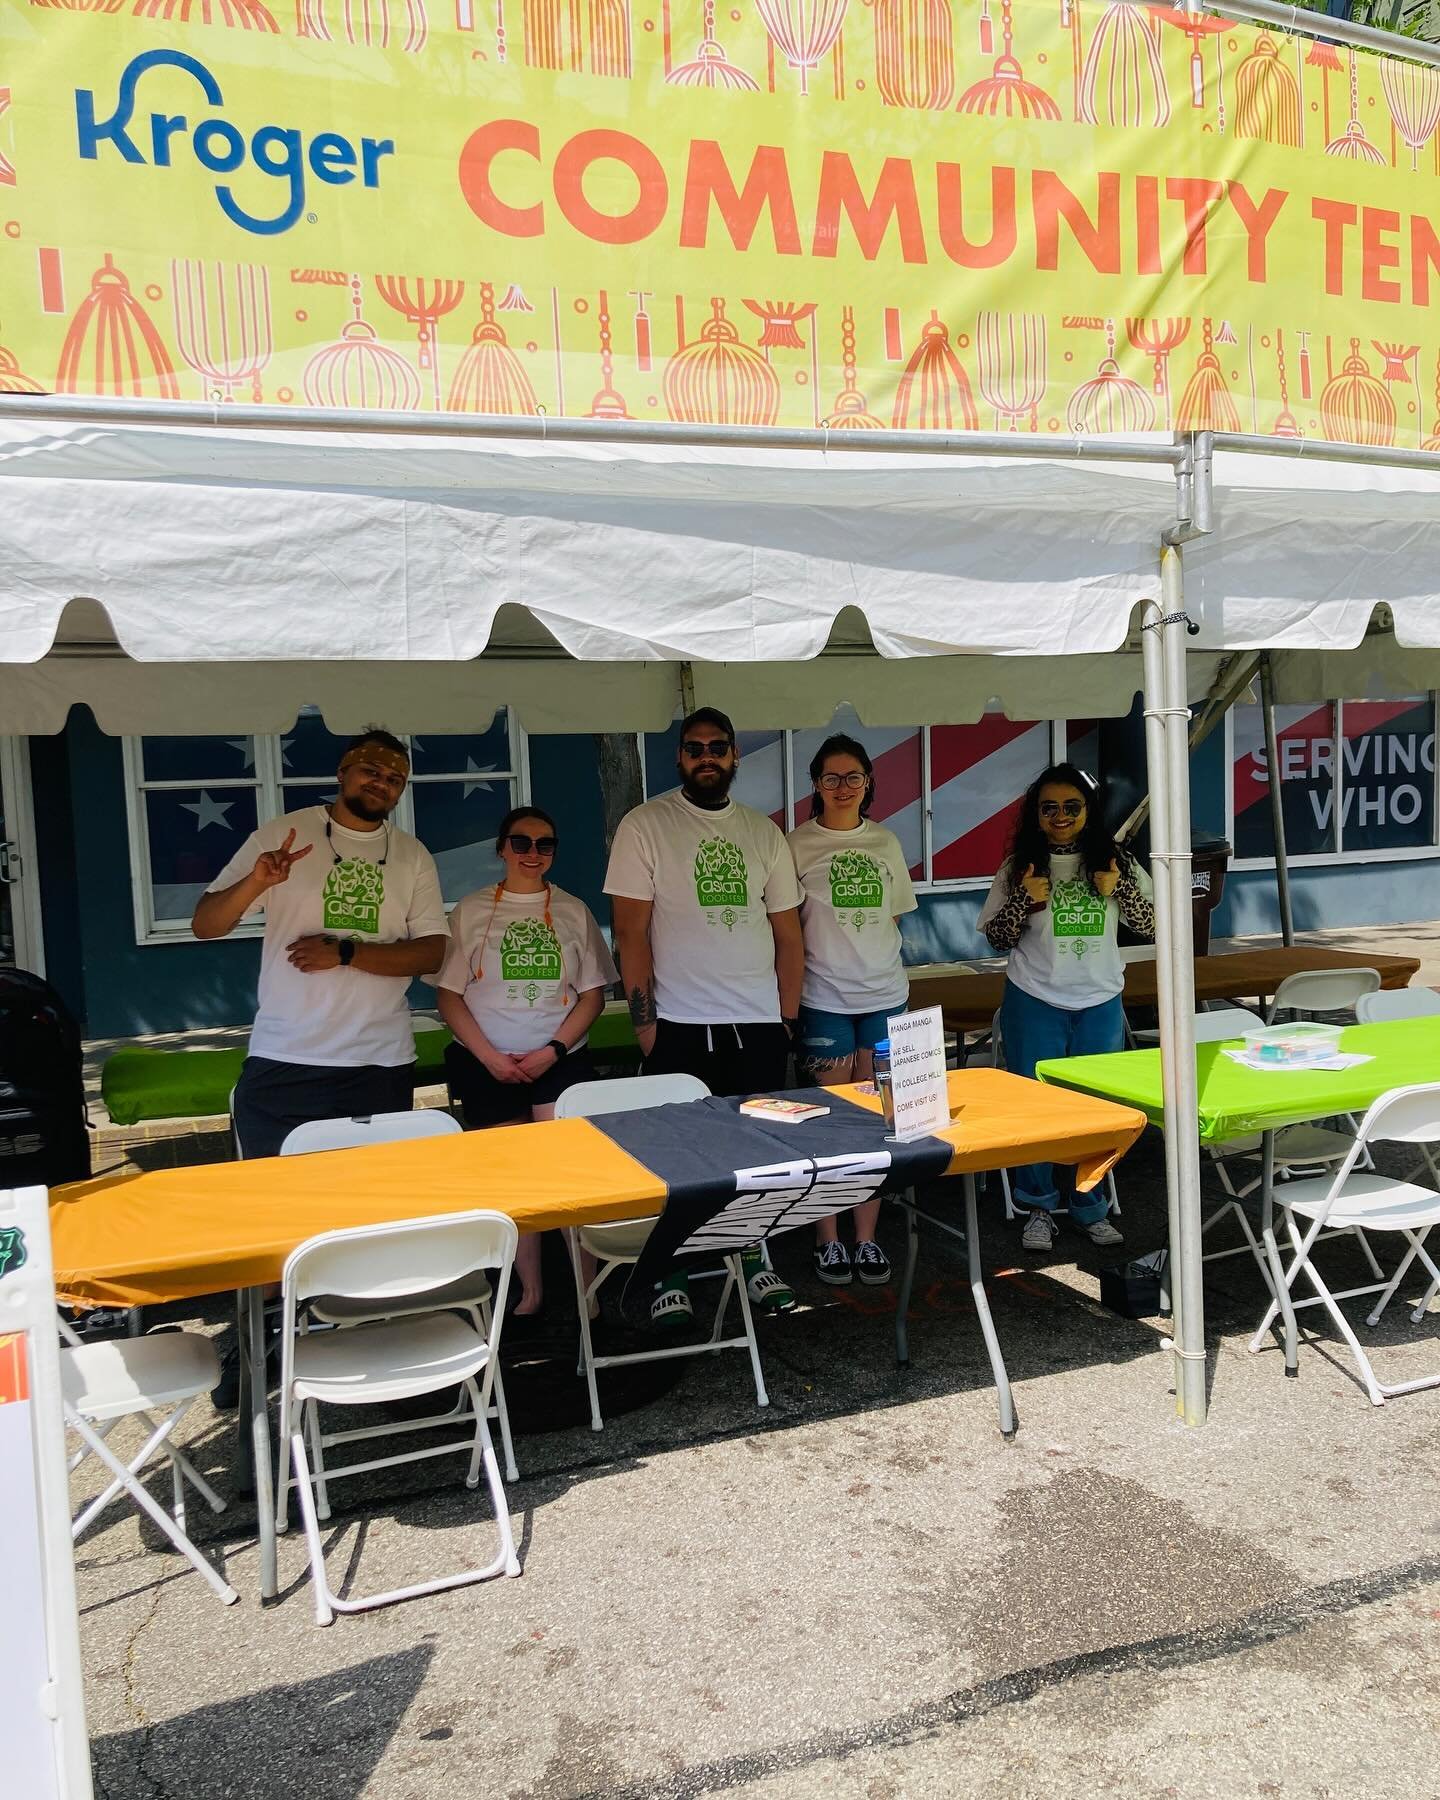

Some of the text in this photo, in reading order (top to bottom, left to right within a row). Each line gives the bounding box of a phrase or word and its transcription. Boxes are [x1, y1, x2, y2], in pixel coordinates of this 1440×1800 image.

[75, 49, 395, 235] Kroger
[459, 119, 1289, 283] COMMUNITY
[1308, 783, 1422, 830] WHO
[701, 881, 744, 894] asian
[836, 884, 880, 897] asian
[328, 900, 377, 920] asian
[1057, 912, 1103, 925] asian
[1058, 925, 1102, 934] FOOD FEST
[506, 953, 558, 967] asian
[506, 968, 558, 977] FOOD FEST
[890, 1016, 933, 1034] MANGA MANGA
[893, 1042, 915, 1056] WE SELL
[893, 1048, 942, 1068] JAPANESE COMICS
[895, 1080, 902, 1090] IN
[901, 1073, 927, 1088] COLLEGE
[896, 1100, 914, 1113] COME
[914, 1095, 928, 1107] VISIT
[754, 1274, 784, 1290] NIK
[652, 1294, 688, 1315] NIKE
